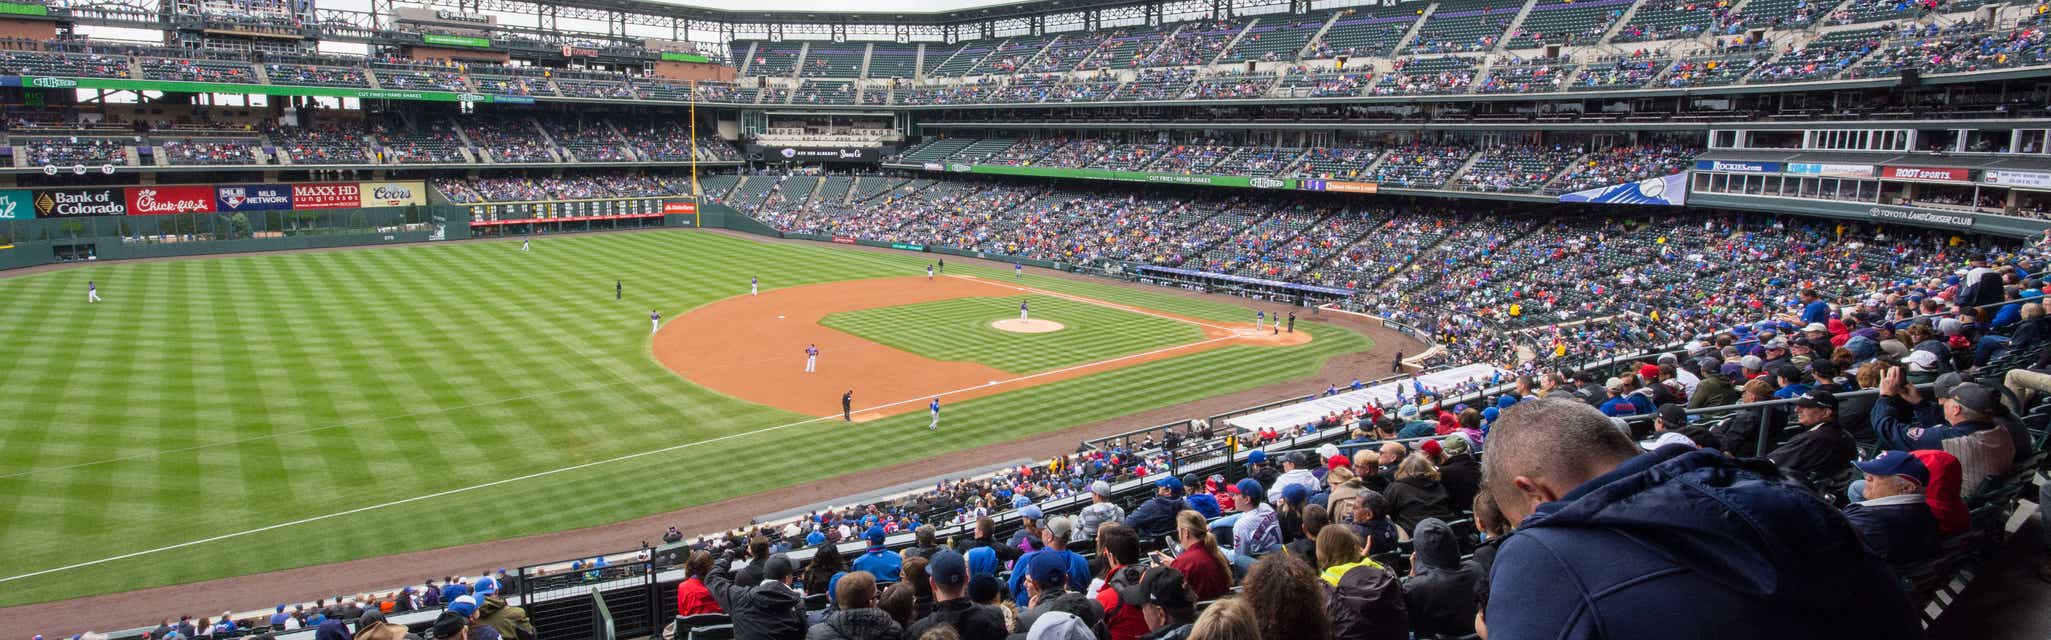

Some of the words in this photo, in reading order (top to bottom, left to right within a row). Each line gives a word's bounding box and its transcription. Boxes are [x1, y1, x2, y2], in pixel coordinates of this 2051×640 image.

[1896, 168, 1921, 178] ROOT
[1919, 170, 1950, 180] SPORTS
[55, 192, 92, 204] Bank
[94, 190, 111, 203] of
[221, 187, 244, 198] MLB
[295, 186, 336, 197] MAXX
[338, 185, 358, 195] HD
[373, 187, 412, 200] Coors
[137, 191, 208, 213] Chick-fil-A
[246, 196, 288, 204] NETWORK
[295, 195, 358, 203] sunglasses
[56, 202, 124, 216] Colorado
[1880, 209, 1907, 219] TOYOTA
[1951, 216, 1973, 226] CLUB
